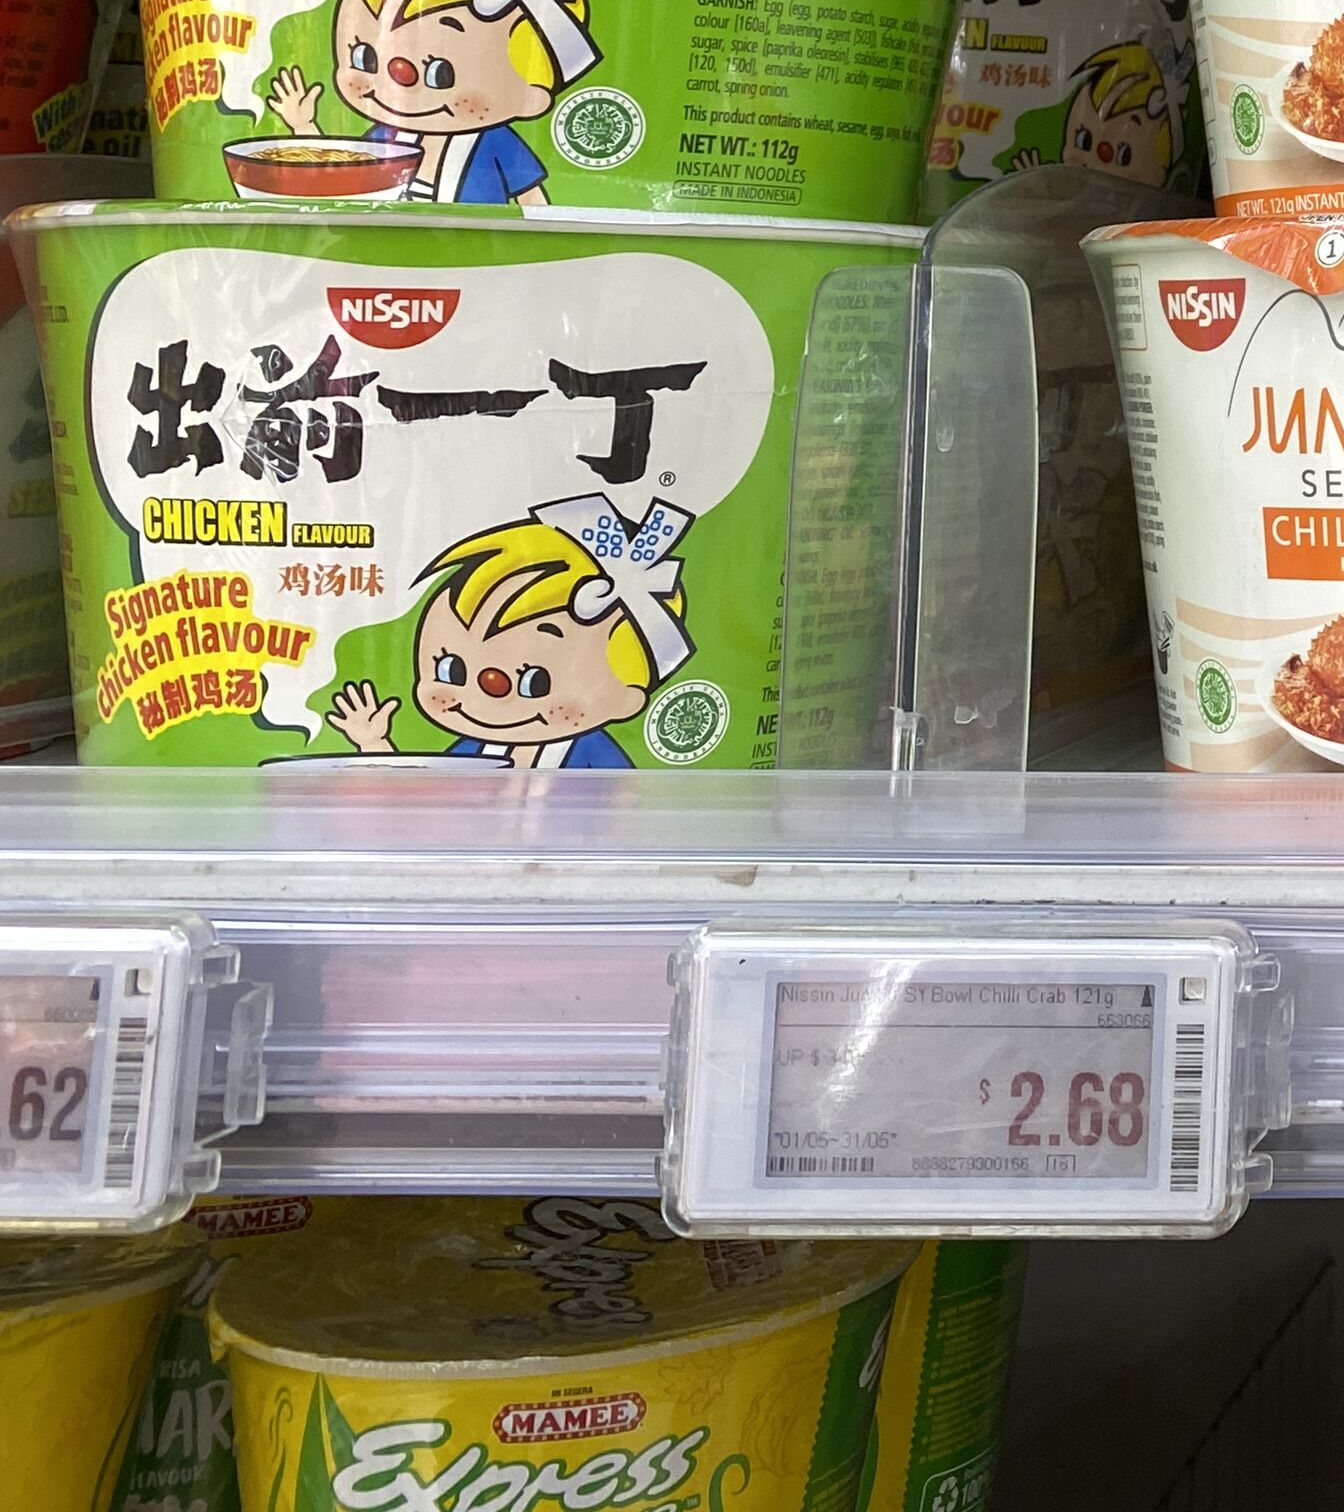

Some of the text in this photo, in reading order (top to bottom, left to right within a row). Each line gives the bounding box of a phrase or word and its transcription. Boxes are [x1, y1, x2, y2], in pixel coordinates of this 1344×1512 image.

[676, 161, 806, 185] INSTANT NOODLES
[680, 135, 798, 164] NET 112g
[342, 294, 444, 329] NISSIN
[1168, 286, 1236, 327] NISSIN
[127, 334, 707, 485] 出前一丁
[142, 499, 374, 548] CHICKEN FLAVOUR
[277, 563, 385, 597] 鸡汤味
[106, 572, 248, 638] Signature
[98, 619, 311, 716] chicken flavour
[135, 668, 258, 731] 秘制鸡汤
[931, 987, 1065, 1005] Bowl Chilli Crab
[8, 1066, 88, 1141] 62
[980, 1071, 1145, 1147] $ 2.68
[511, 1403, 631, 1437] MAMEE
[333, 1422, 709, 1512] Express
